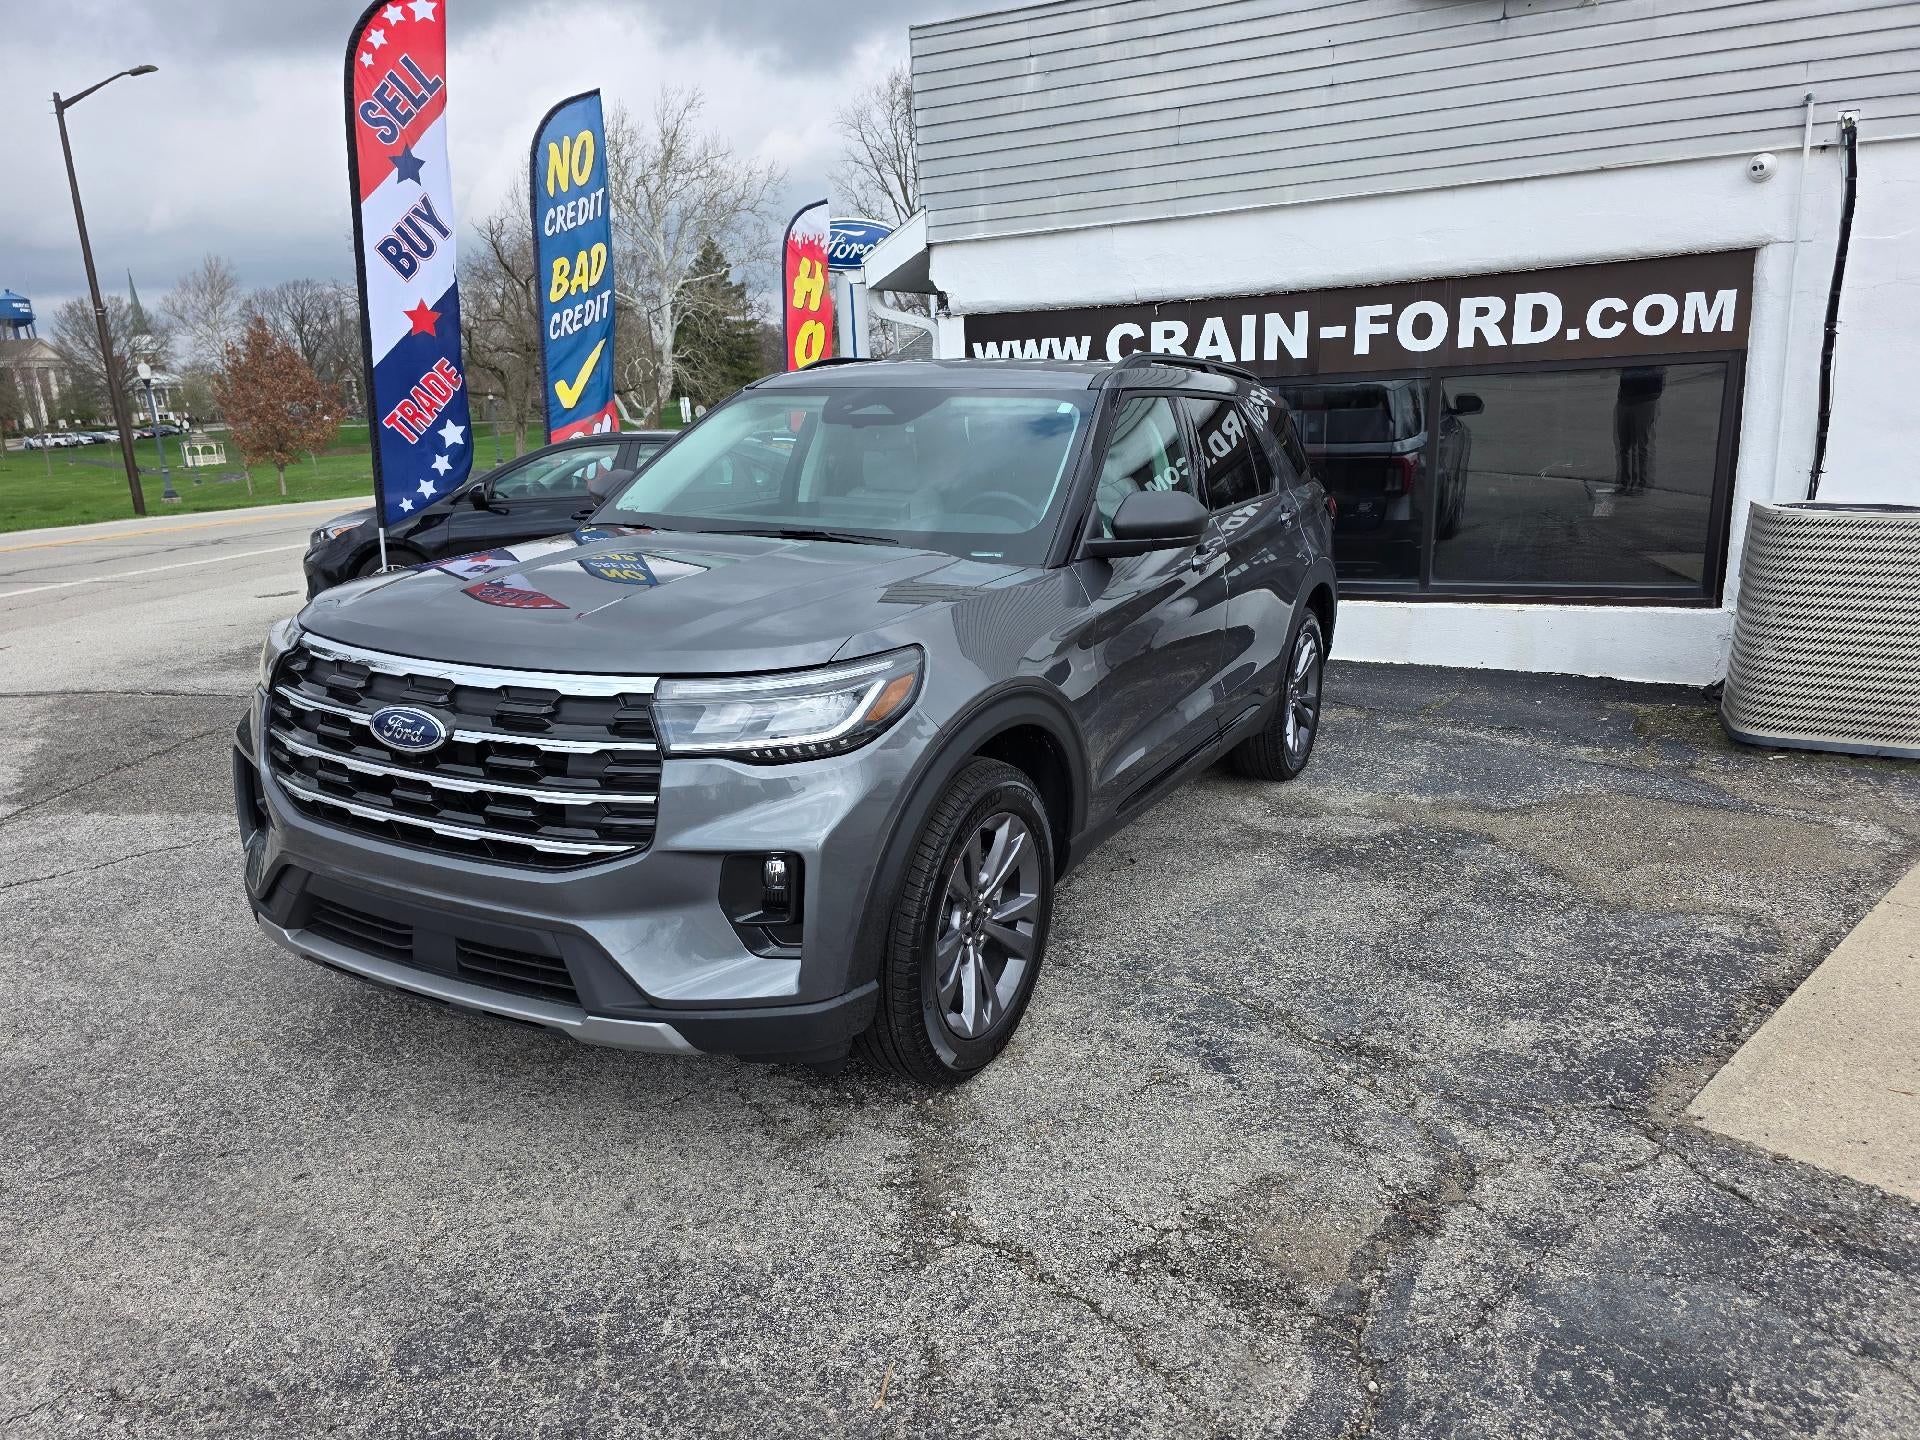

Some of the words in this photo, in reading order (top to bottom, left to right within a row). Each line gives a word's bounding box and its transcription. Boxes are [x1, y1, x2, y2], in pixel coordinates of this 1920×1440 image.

[359, 53, 444, 145] SELL
[547, 130, 595, 197] NO
[375, 192, 452, 283] BUY
[544, 187, 605, 236] CREDIT
[550, 242, 607, 303] BAD
[549, 289, 612, 340] CREDIT
[382, 356, 463, 444] TRADE
[383, 714, 425, 742] Ford
